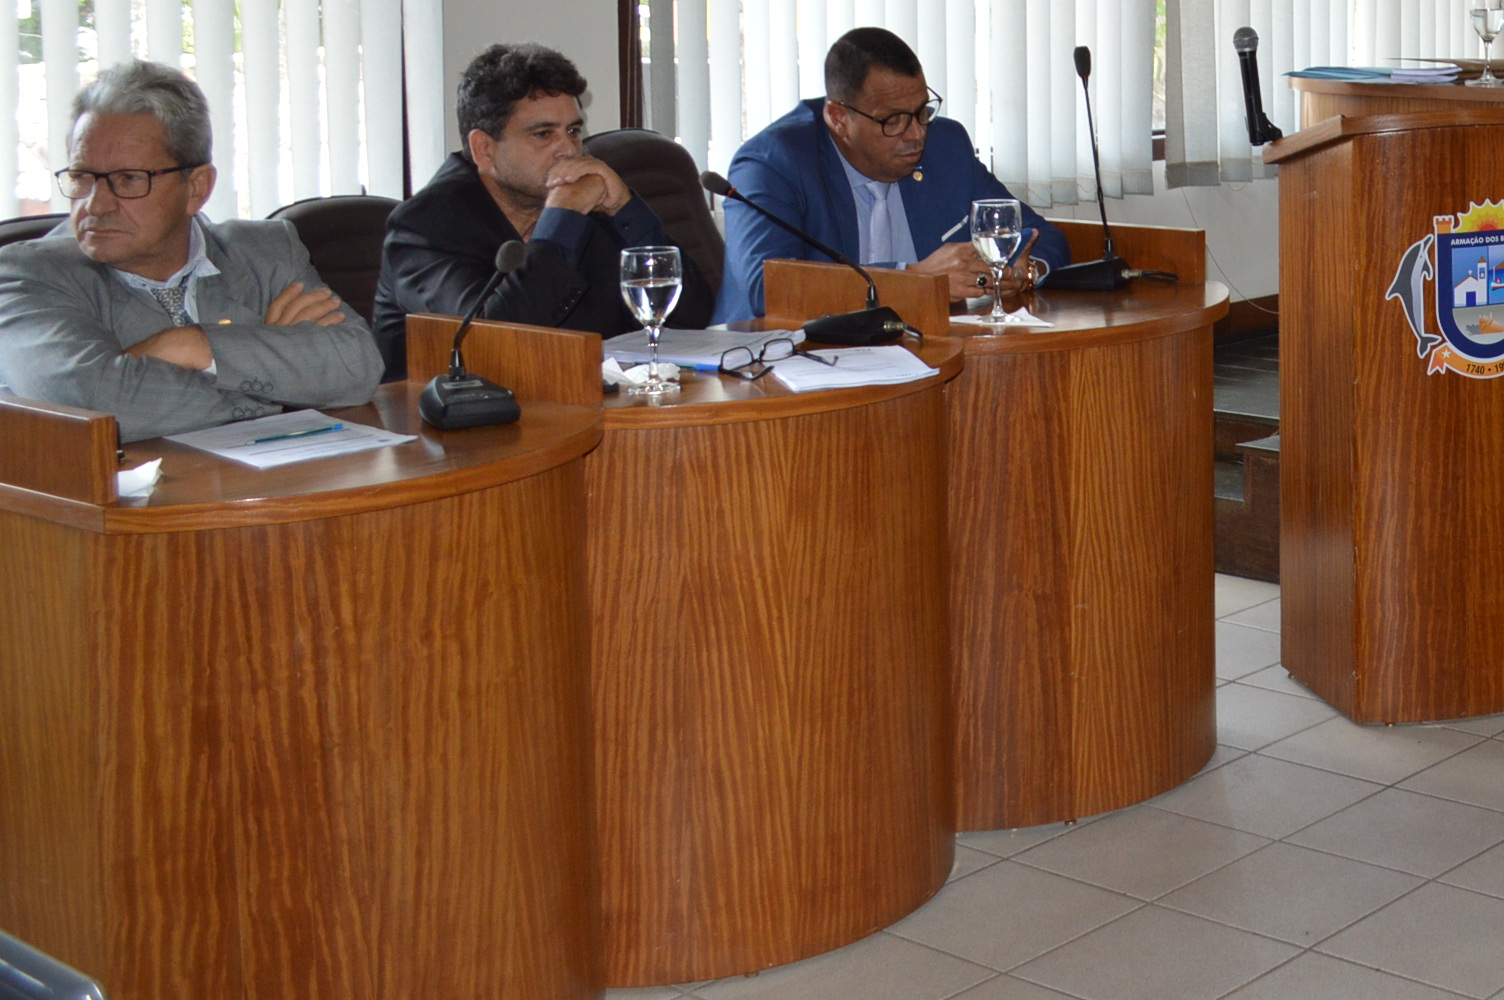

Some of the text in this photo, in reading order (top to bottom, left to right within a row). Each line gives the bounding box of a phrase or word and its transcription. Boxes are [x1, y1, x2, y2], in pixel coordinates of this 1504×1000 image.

[1450, 235, 1484, 246] ARMAÇÃO
[1485, 235, 1499, 244] DOS
[1466, 363, 1485, 375] 1740
